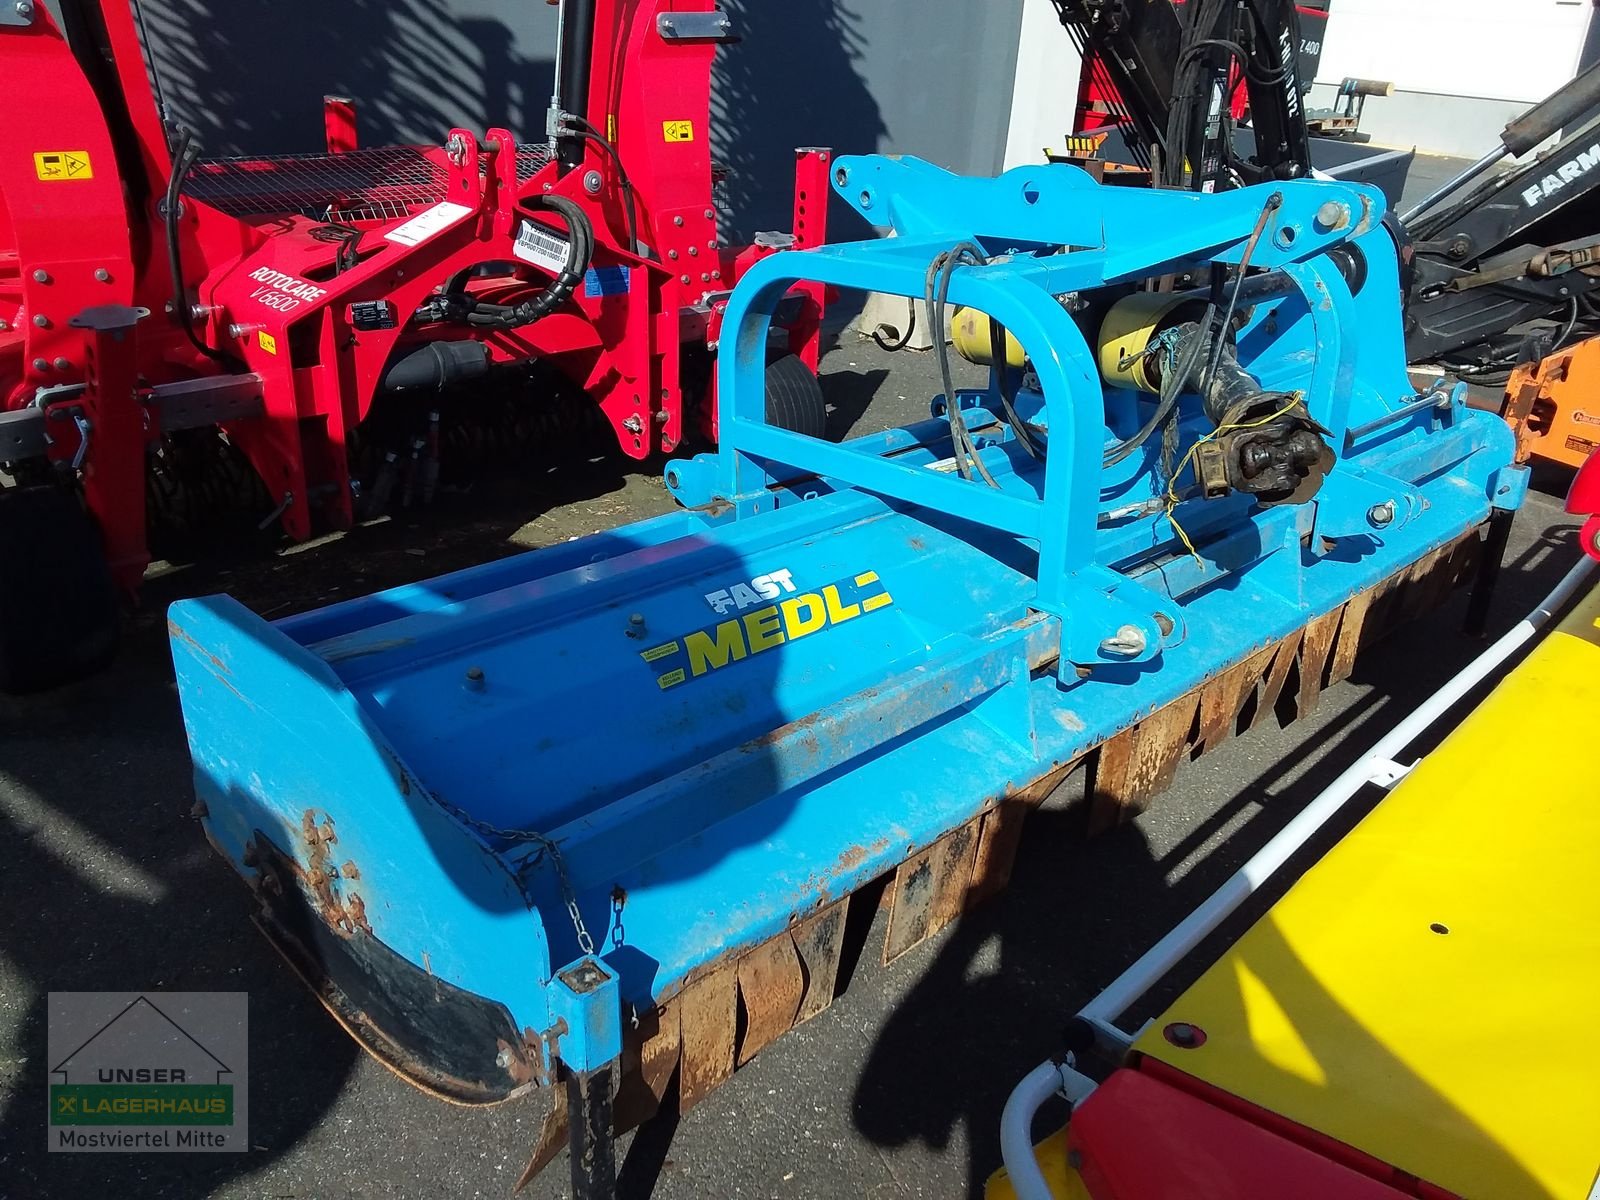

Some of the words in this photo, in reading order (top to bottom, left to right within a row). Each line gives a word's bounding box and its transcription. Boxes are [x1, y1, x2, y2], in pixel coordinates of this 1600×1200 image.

[1305, 41, 1320, 55] 400
[247, 265, 328, 303] ROTOCARE
[704, 567, 797, 615] FAST
[683, 584, 861, 677] MEDL
